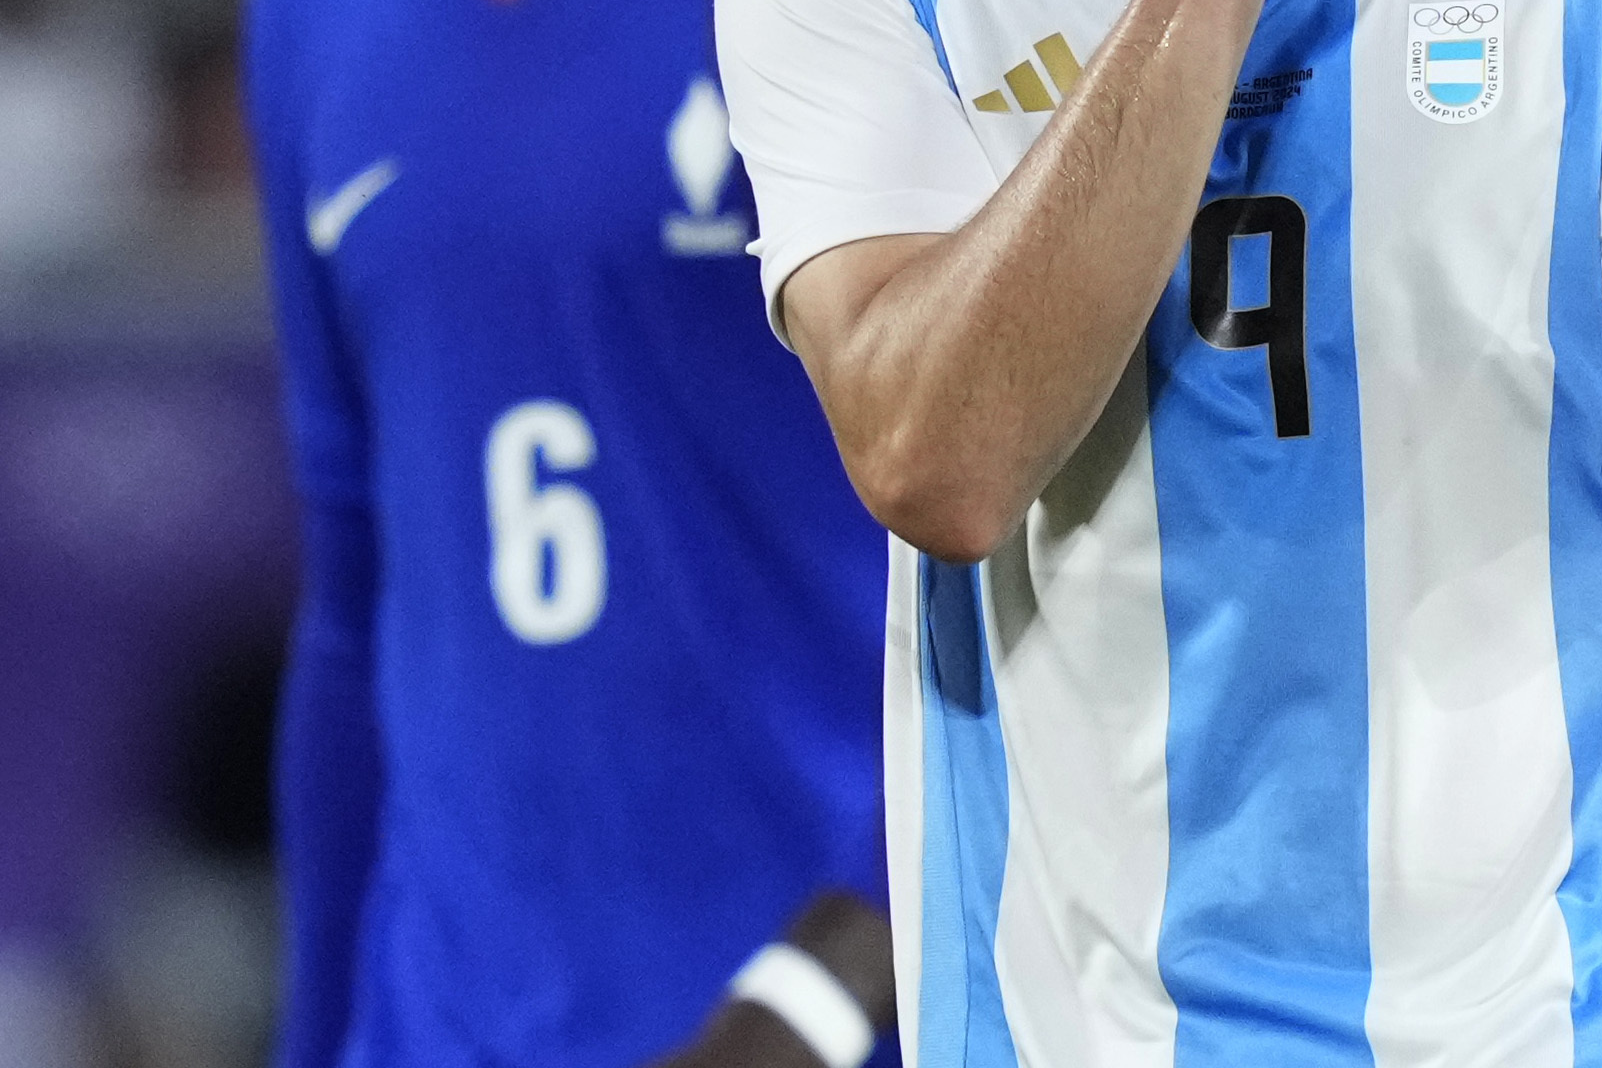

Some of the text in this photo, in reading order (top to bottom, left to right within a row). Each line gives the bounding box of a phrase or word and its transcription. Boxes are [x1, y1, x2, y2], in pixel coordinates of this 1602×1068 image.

[1253, 67, 1313, 90] ARGENTINA
[1271, 85, 1301, 102] 2024
[1411, 36, 1499, 119] COMITE OLIMPICO ARGENTINO
[1189, 195, 1311, 439] 9
[484, 396, 609, 646] 6
